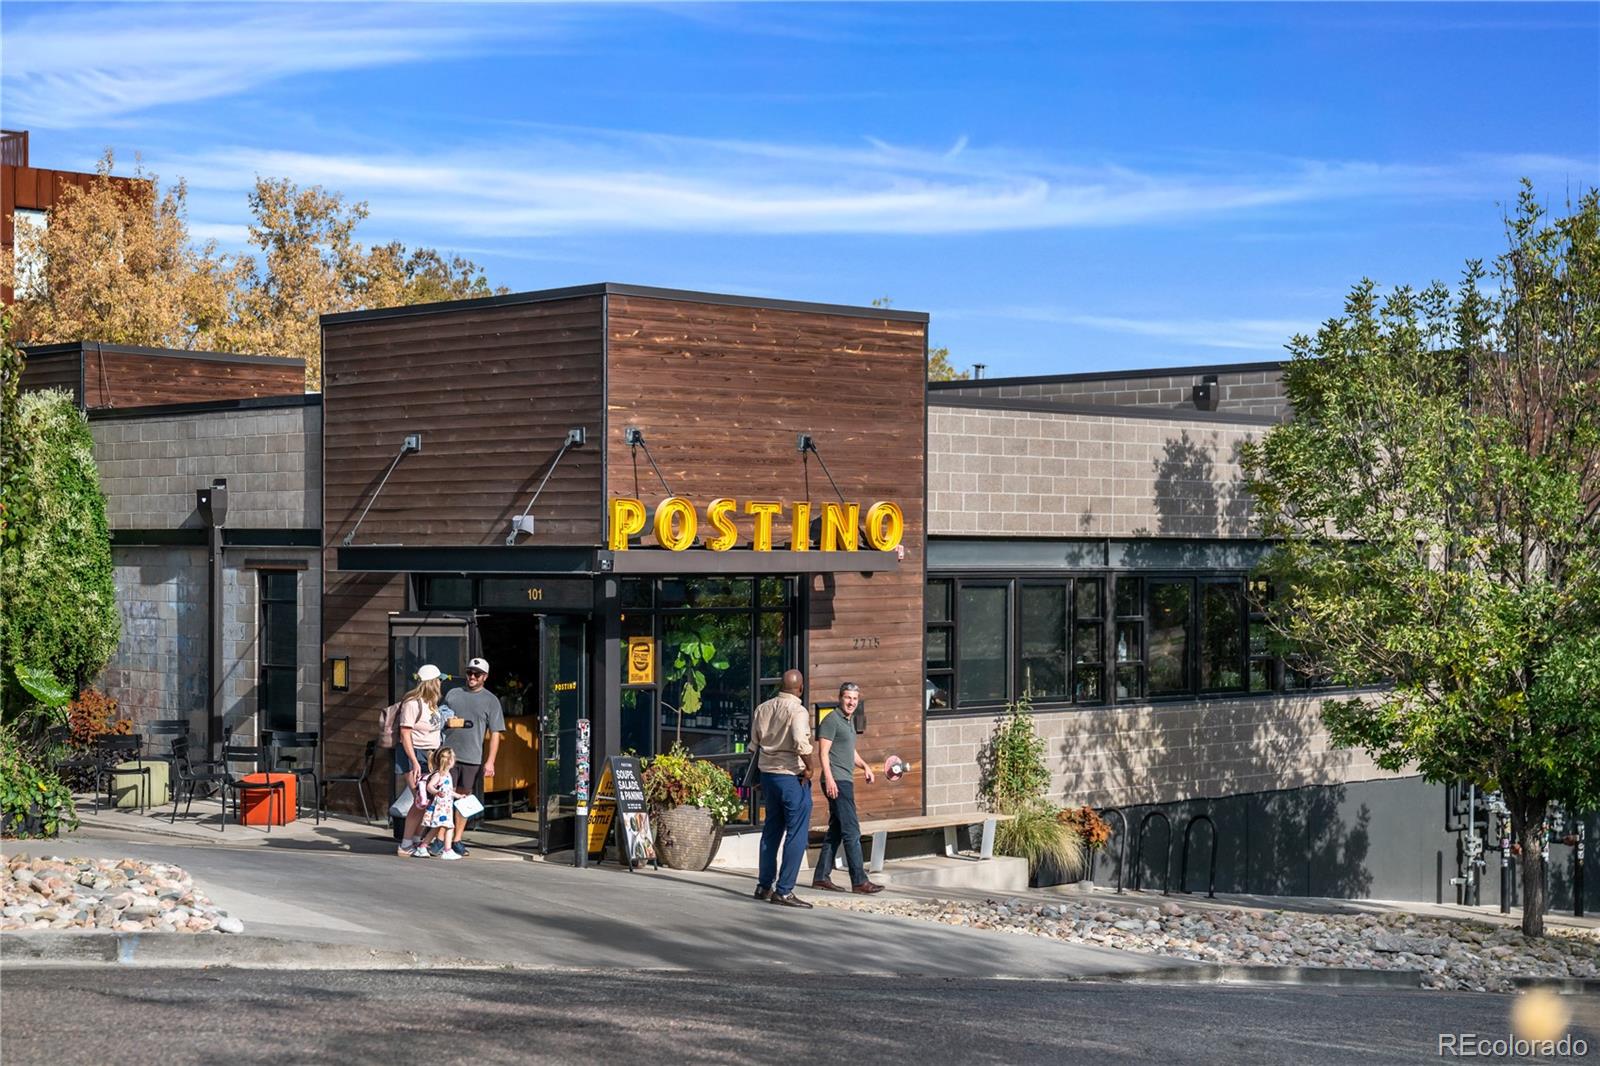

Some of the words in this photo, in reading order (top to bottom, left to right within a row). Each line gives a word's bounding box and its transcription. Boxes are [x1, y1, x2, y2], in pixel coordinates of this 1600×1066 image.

[608, 497, 904, 551] POSTINO
[528, 588, 543, 601] 101
[853, 637, 880, 649] 2715
